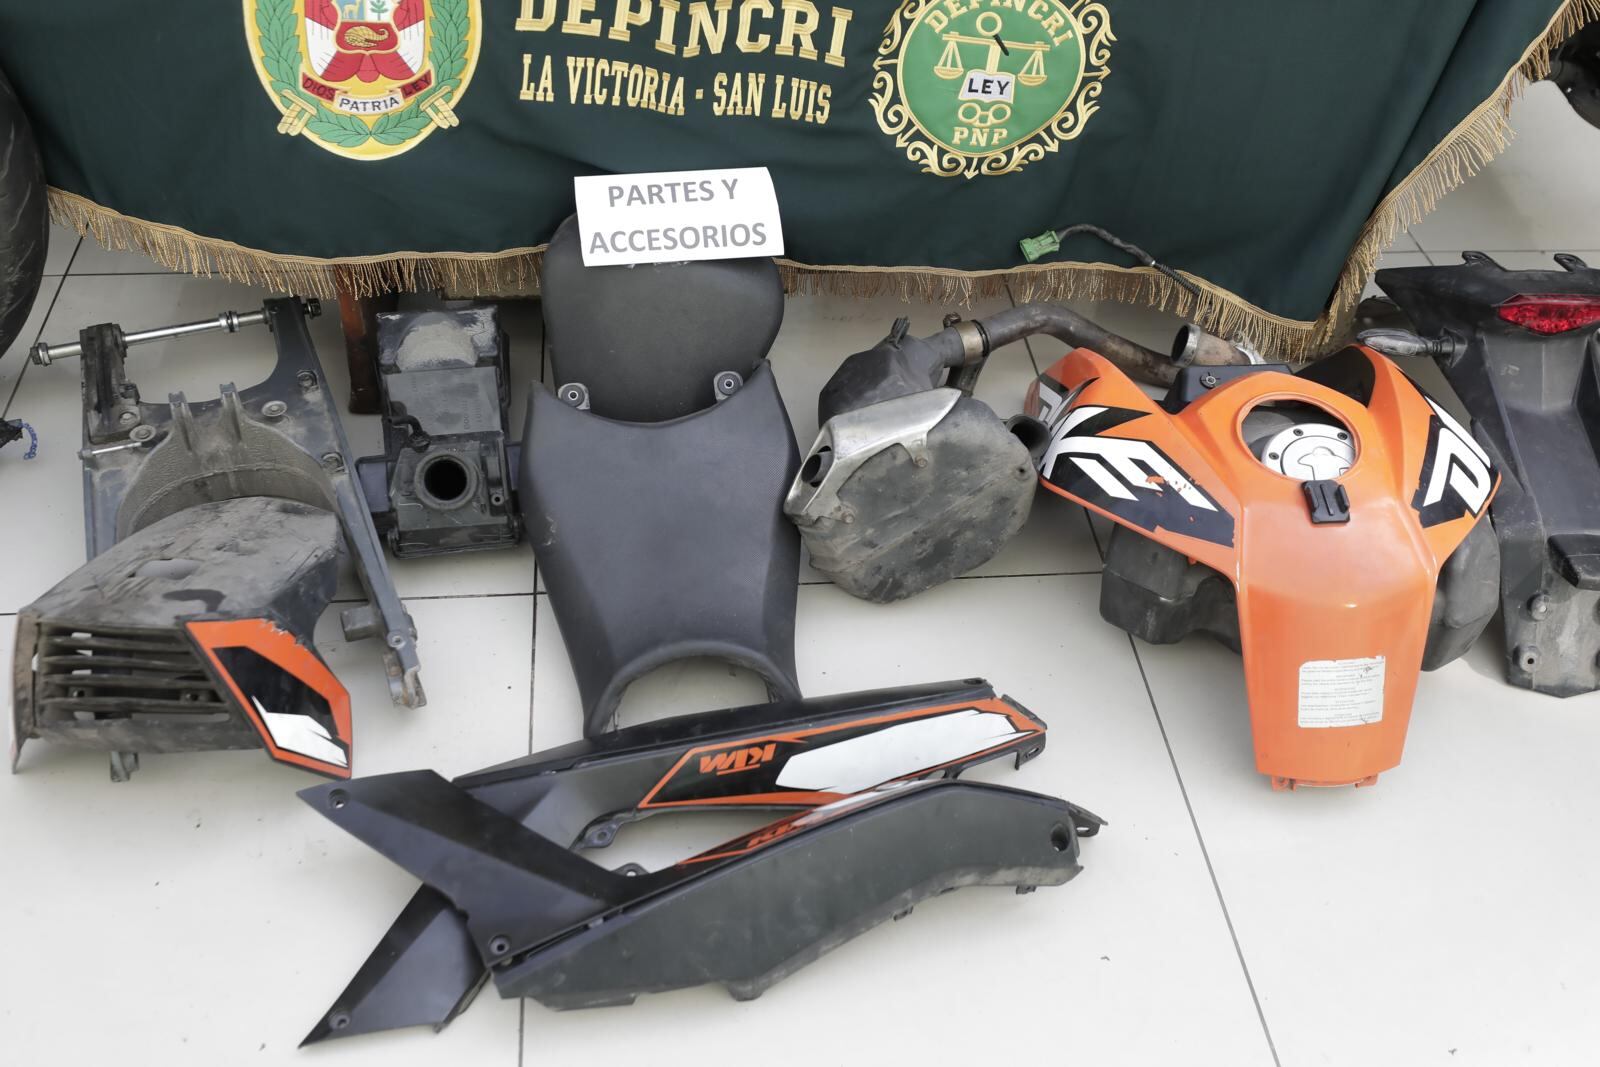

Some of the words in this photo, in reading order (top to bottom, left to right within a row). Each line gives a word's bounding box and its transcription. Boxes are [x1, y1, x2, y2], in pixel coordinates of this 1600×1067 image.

[515, 0, 853, 67] DEPINCRI
[924, 0, 1073, 47] DENCRI
[303, 77, 335, 101] DIOS
[339, 96, 400, 112] PATRIA
[402, 74, 431, 96] LEY
[519, 53, 554, 102] LA
[566, 55, 685, 116] VICTORIA
[713, 72, 766, 116] SAN
[772, 74, 832, 124] LUIS
[967, 78, 1010, 96] LEY
[952, 126, 1008, 147] PNP
[607, 180, 715, 207] PARTES
[721, 178, 738, 200] Y
[589, 222, 767, 254] ACCESORIOS
[699, 743, 777, 776] KTM
